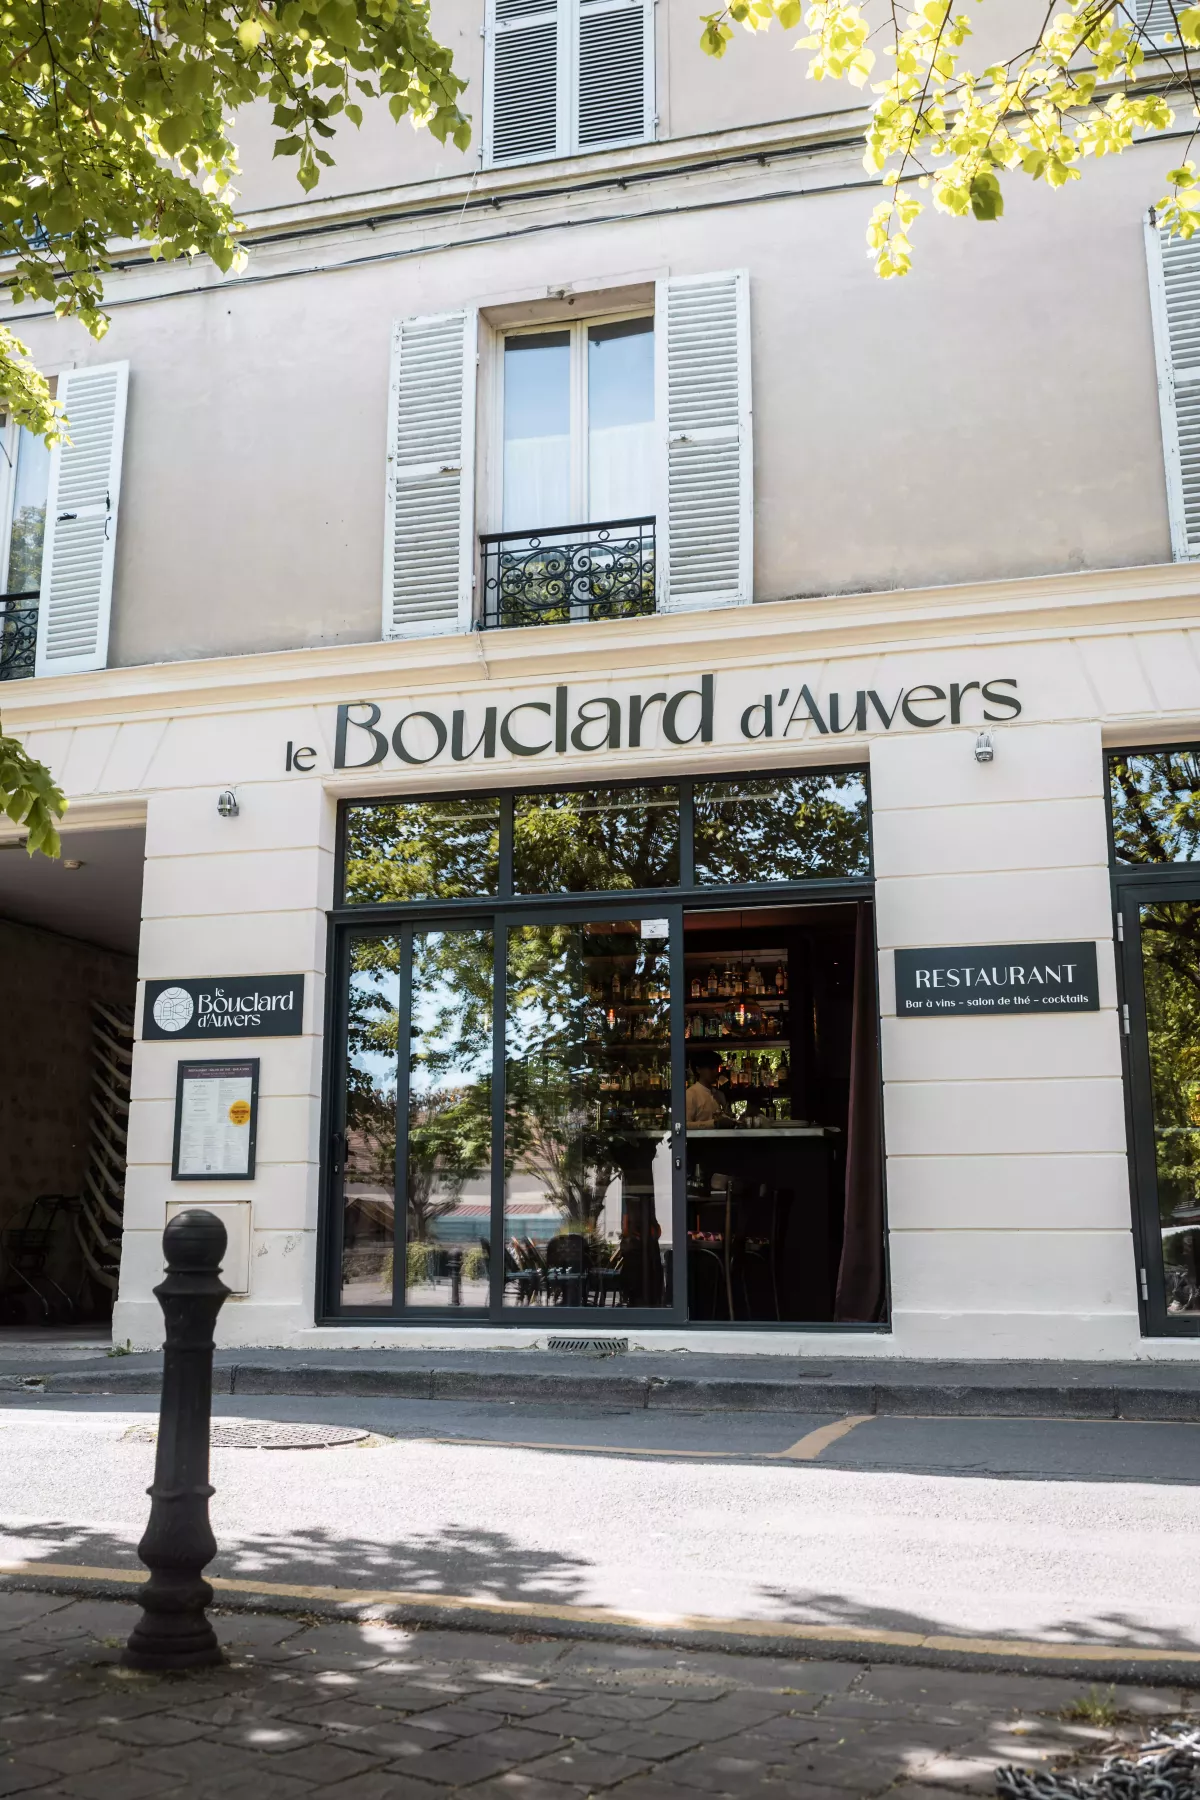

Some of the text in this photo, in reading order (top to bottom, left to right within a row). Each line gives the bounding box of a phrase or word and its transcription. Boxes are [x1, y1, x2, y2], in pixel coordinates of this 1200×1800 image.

[285, 674, 1022, 772] le Bouclard d'Auvers
[915, 964, 1077, 989] RESTAURANT
[215, 987, 225, 997] le
[905, 999, 923, 1009] Bar
[925, 999, 933, 1008] à
[935, 998, 956, 1008] vins
[966, 997, 995, 1006] salon
[997, 996, 1011, 1006] de
[1013, 995, 1031, 1005] thé
[1042, 994, 1089, 1004] cocktails
[198, 990, 294, 1014] Bouclard
[197, 1013, 261, 1028] d'Auvers
